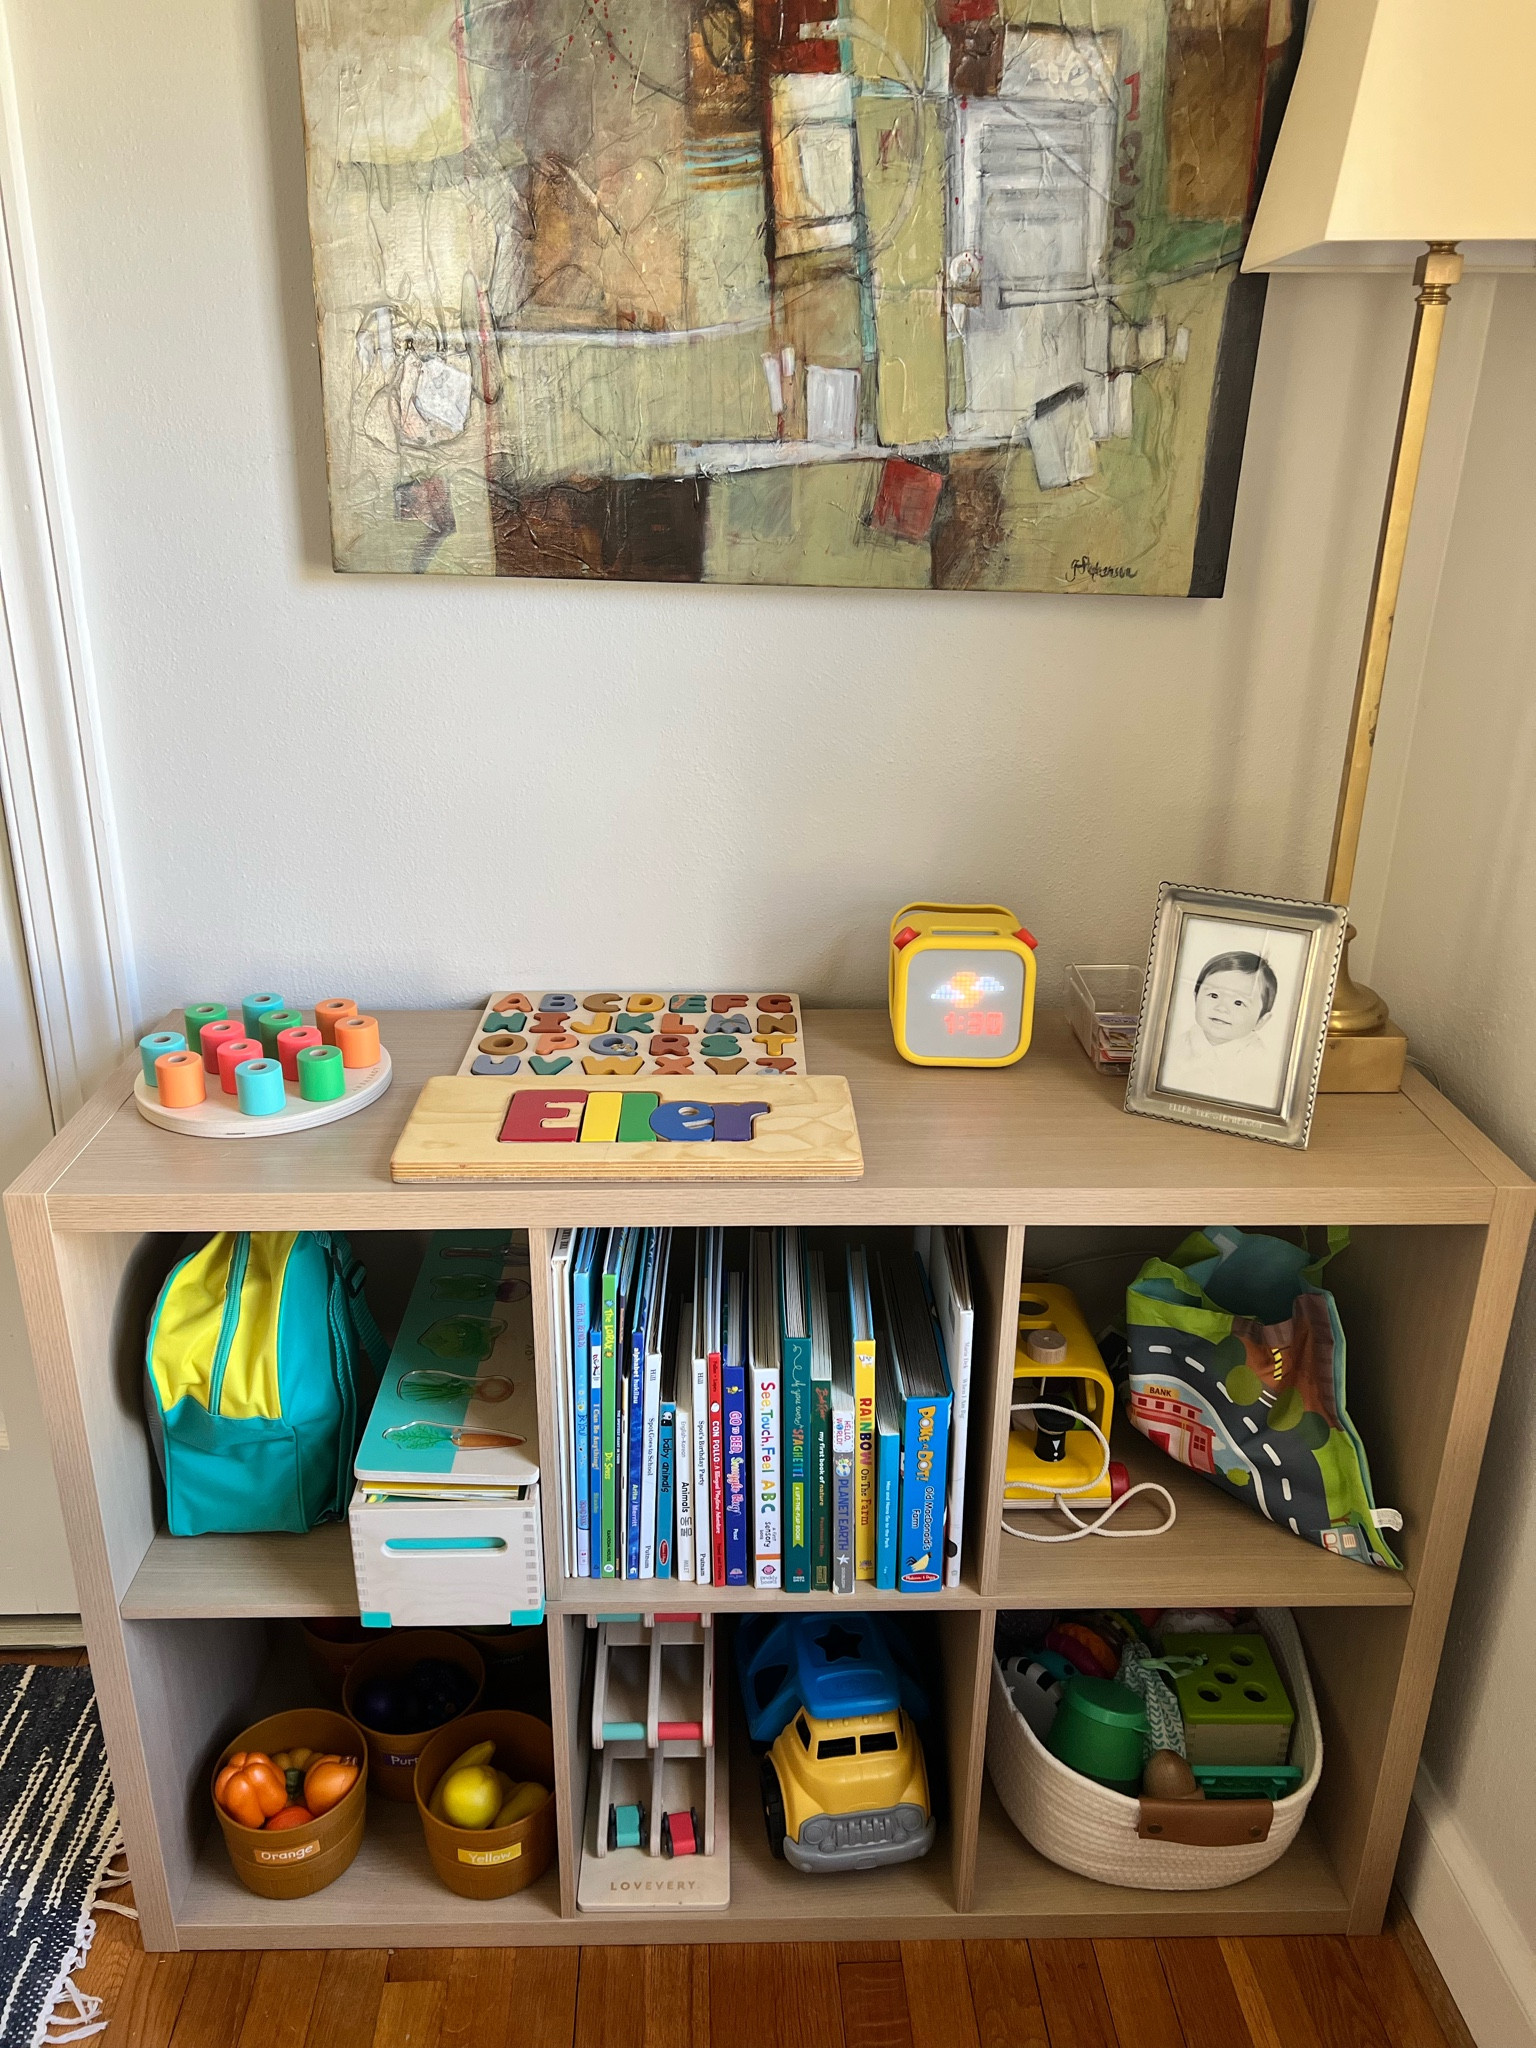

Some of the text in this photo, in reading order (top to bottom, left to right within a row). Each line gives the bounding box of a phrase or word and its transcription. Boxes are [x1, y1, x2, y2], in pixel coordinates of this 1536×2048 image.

[944, 1011, 1003, 1035] 1:30
[499, 1089, 771, 1142] Eller
[604, 1309, 615, 1350] The LORAX
[632, 1348, 640, 1377] alphabet
[791, 1388, 801, 1405] you
[1149, 1387, 1171, 1397] BANK
[712, 1420, 720, 1437] CON
[730, 1411, 742, 1426] GO
[794, 1406, 802, 1426] were
[918, 1405, 936, 1442] POKE
[593, 1425, 600, 1434] Be
[697, 1421, 705, 1439] Spot's
[818, 1432, 824, 1442] my
[592, 1436, 600, 1470] Anything!
[697, 1440, 705, 1468] Birthday
[729, 1435, 742, 1454] BED,
[792, 1429, 804, 1477] SPAGHETTI
[604, 1452, 613, 1479] Dr. Seuss
[660, 1438, 672, 1492] baby animals
[761, 1447, 775, 1473] Feel
[859, 1398, 872, 1526] RAINBOW On The Farm
[916, 1450, 934, 1482] DOT!
[727, 1457, 744, 1493] Snuggle
[819, 1476, 825, 1484] of
[681, 1482, 690, 1513] Animals
[838, 1479, 849, 1550] PLANET EARTH
[912, 1509, 921, 1528] Farm
[923, 1486, 934, 1550] Old MacDonald's
[261, 1845, 313, 1860] Orange
[468, 1852, 511, 1863] Yellow
[610, 1881, 695, 1891] LOVEVERY
